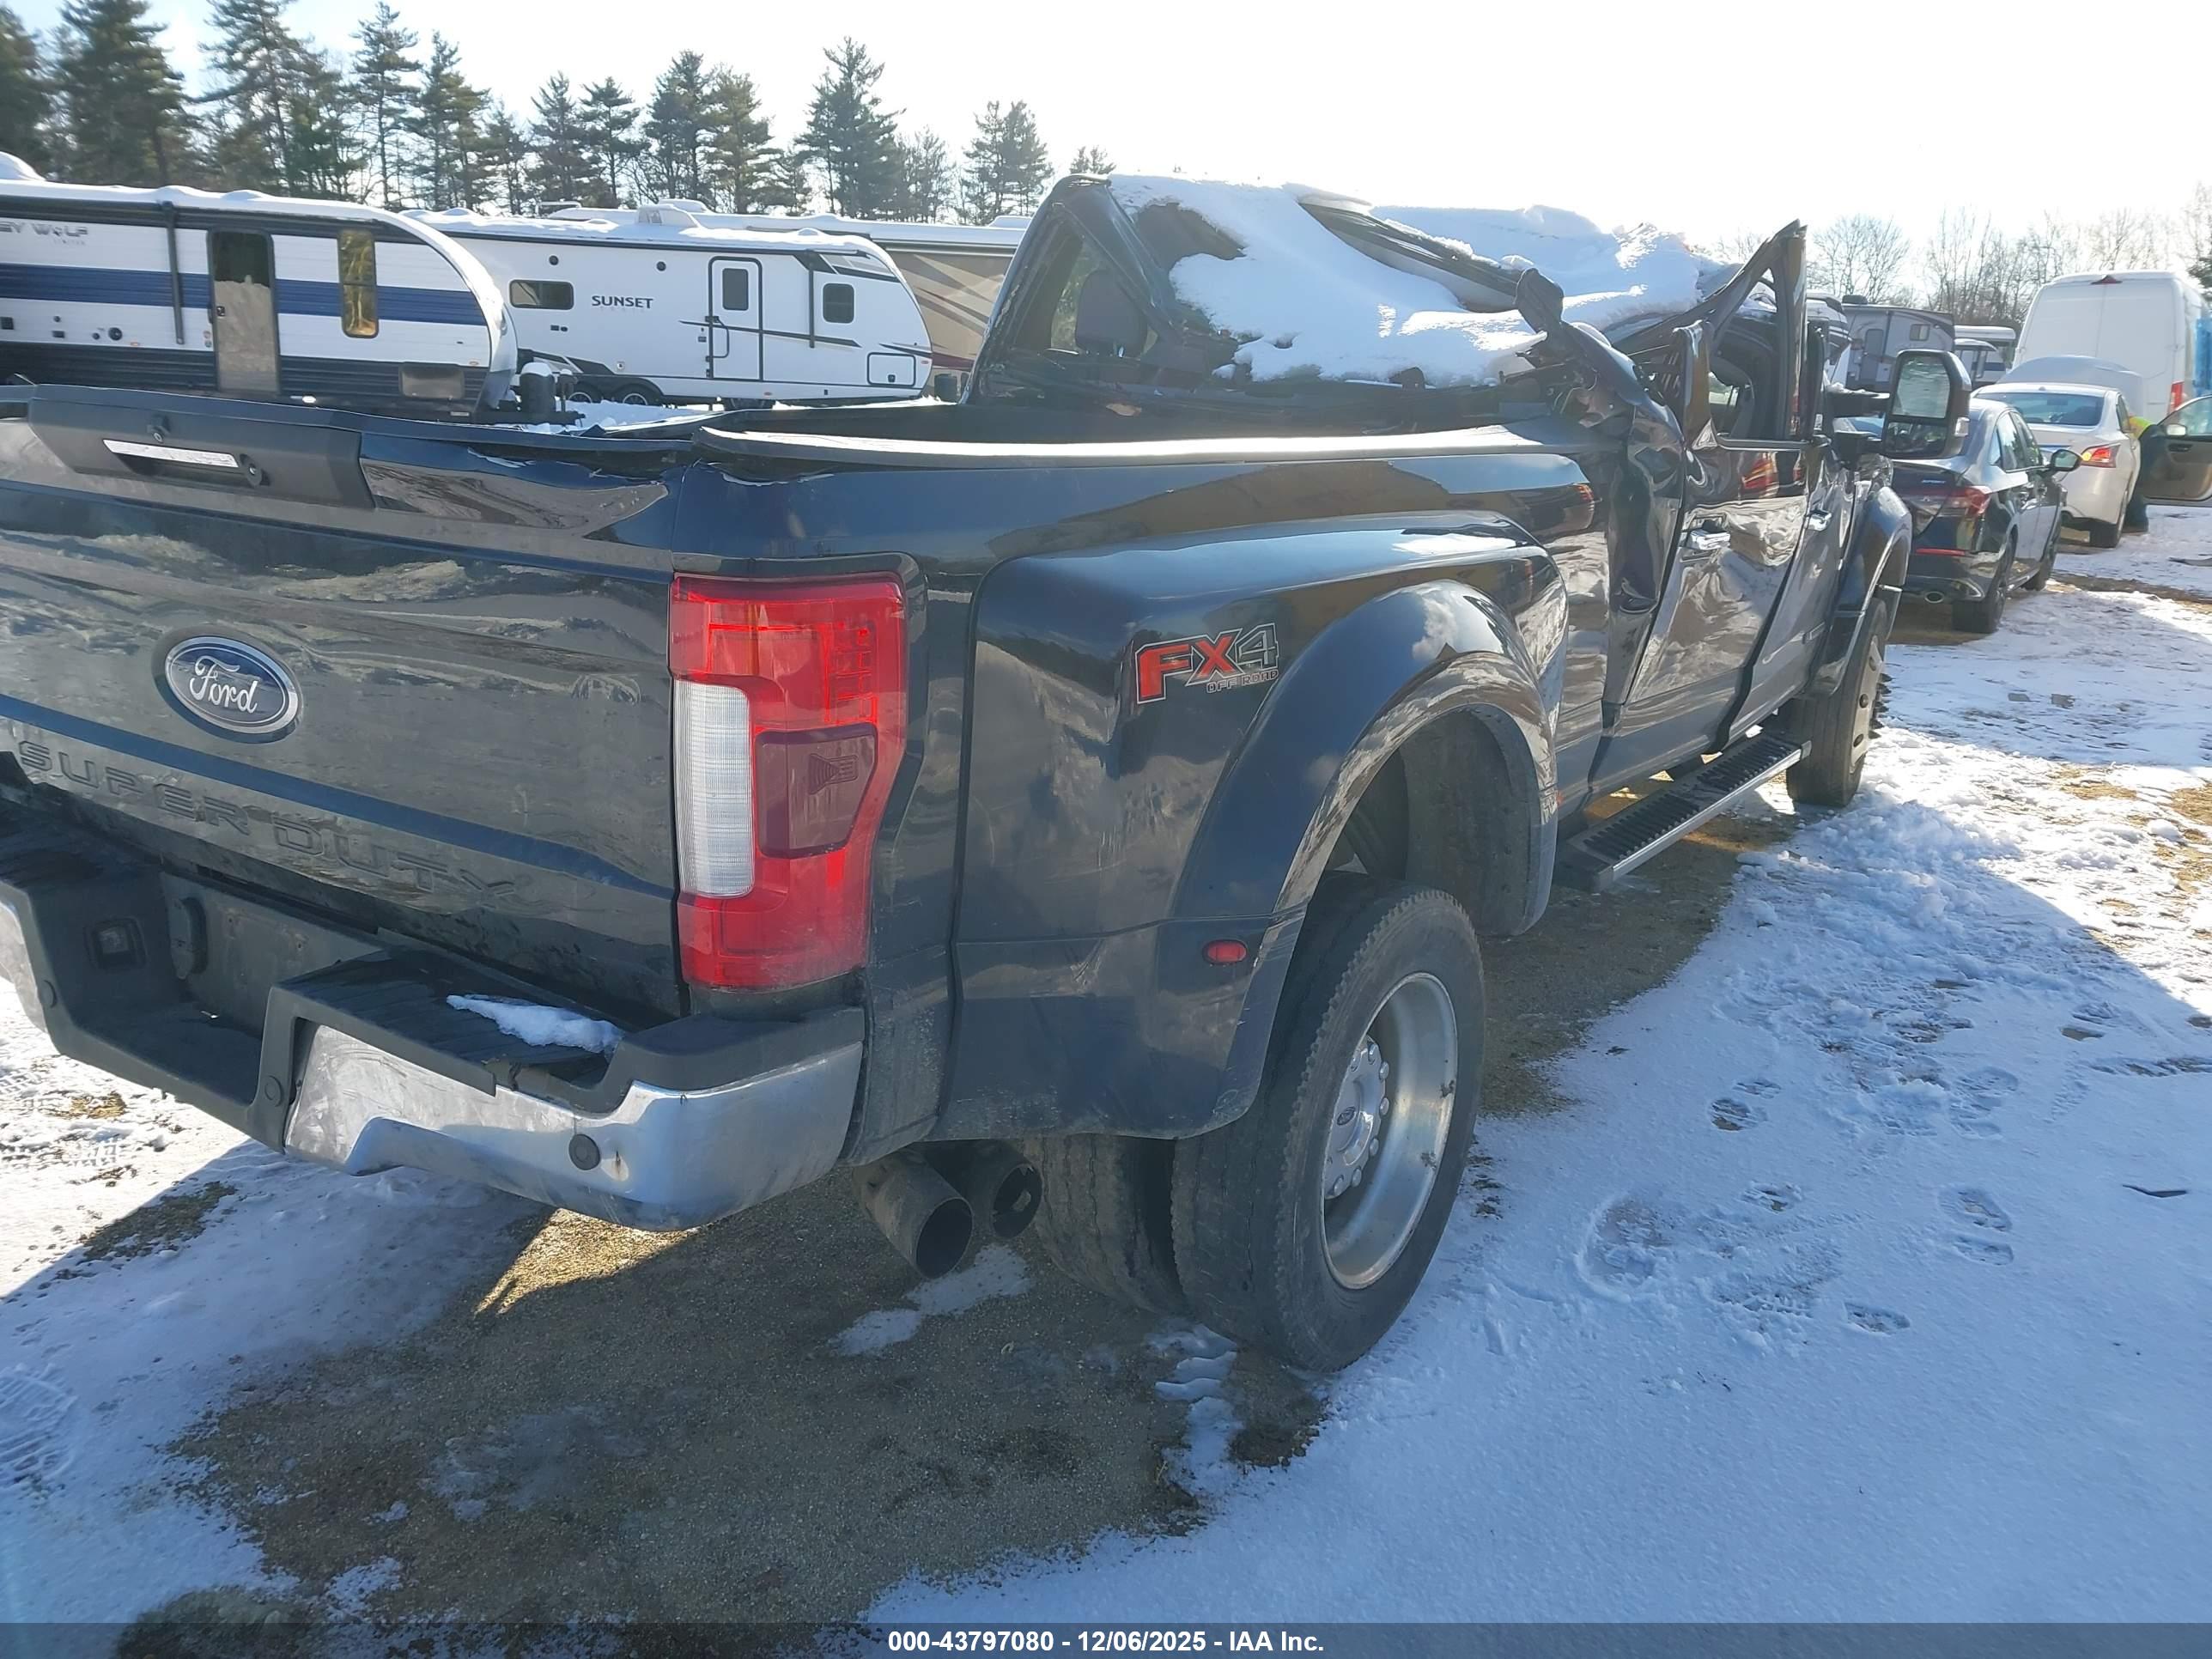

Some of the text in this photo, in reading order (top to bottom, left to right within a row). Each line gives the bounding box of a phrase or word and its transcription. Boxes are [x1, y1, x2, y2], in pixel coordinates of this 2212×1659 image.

[591, 295, 653, 309] SUNSET
[189, 655, 258, 714] Ford
[1135, 623, 1279, 704] FX4
[1206, 669, 1279, 693] OFF ROAD
[18, 739, 517, 908] SUPER DUTY
